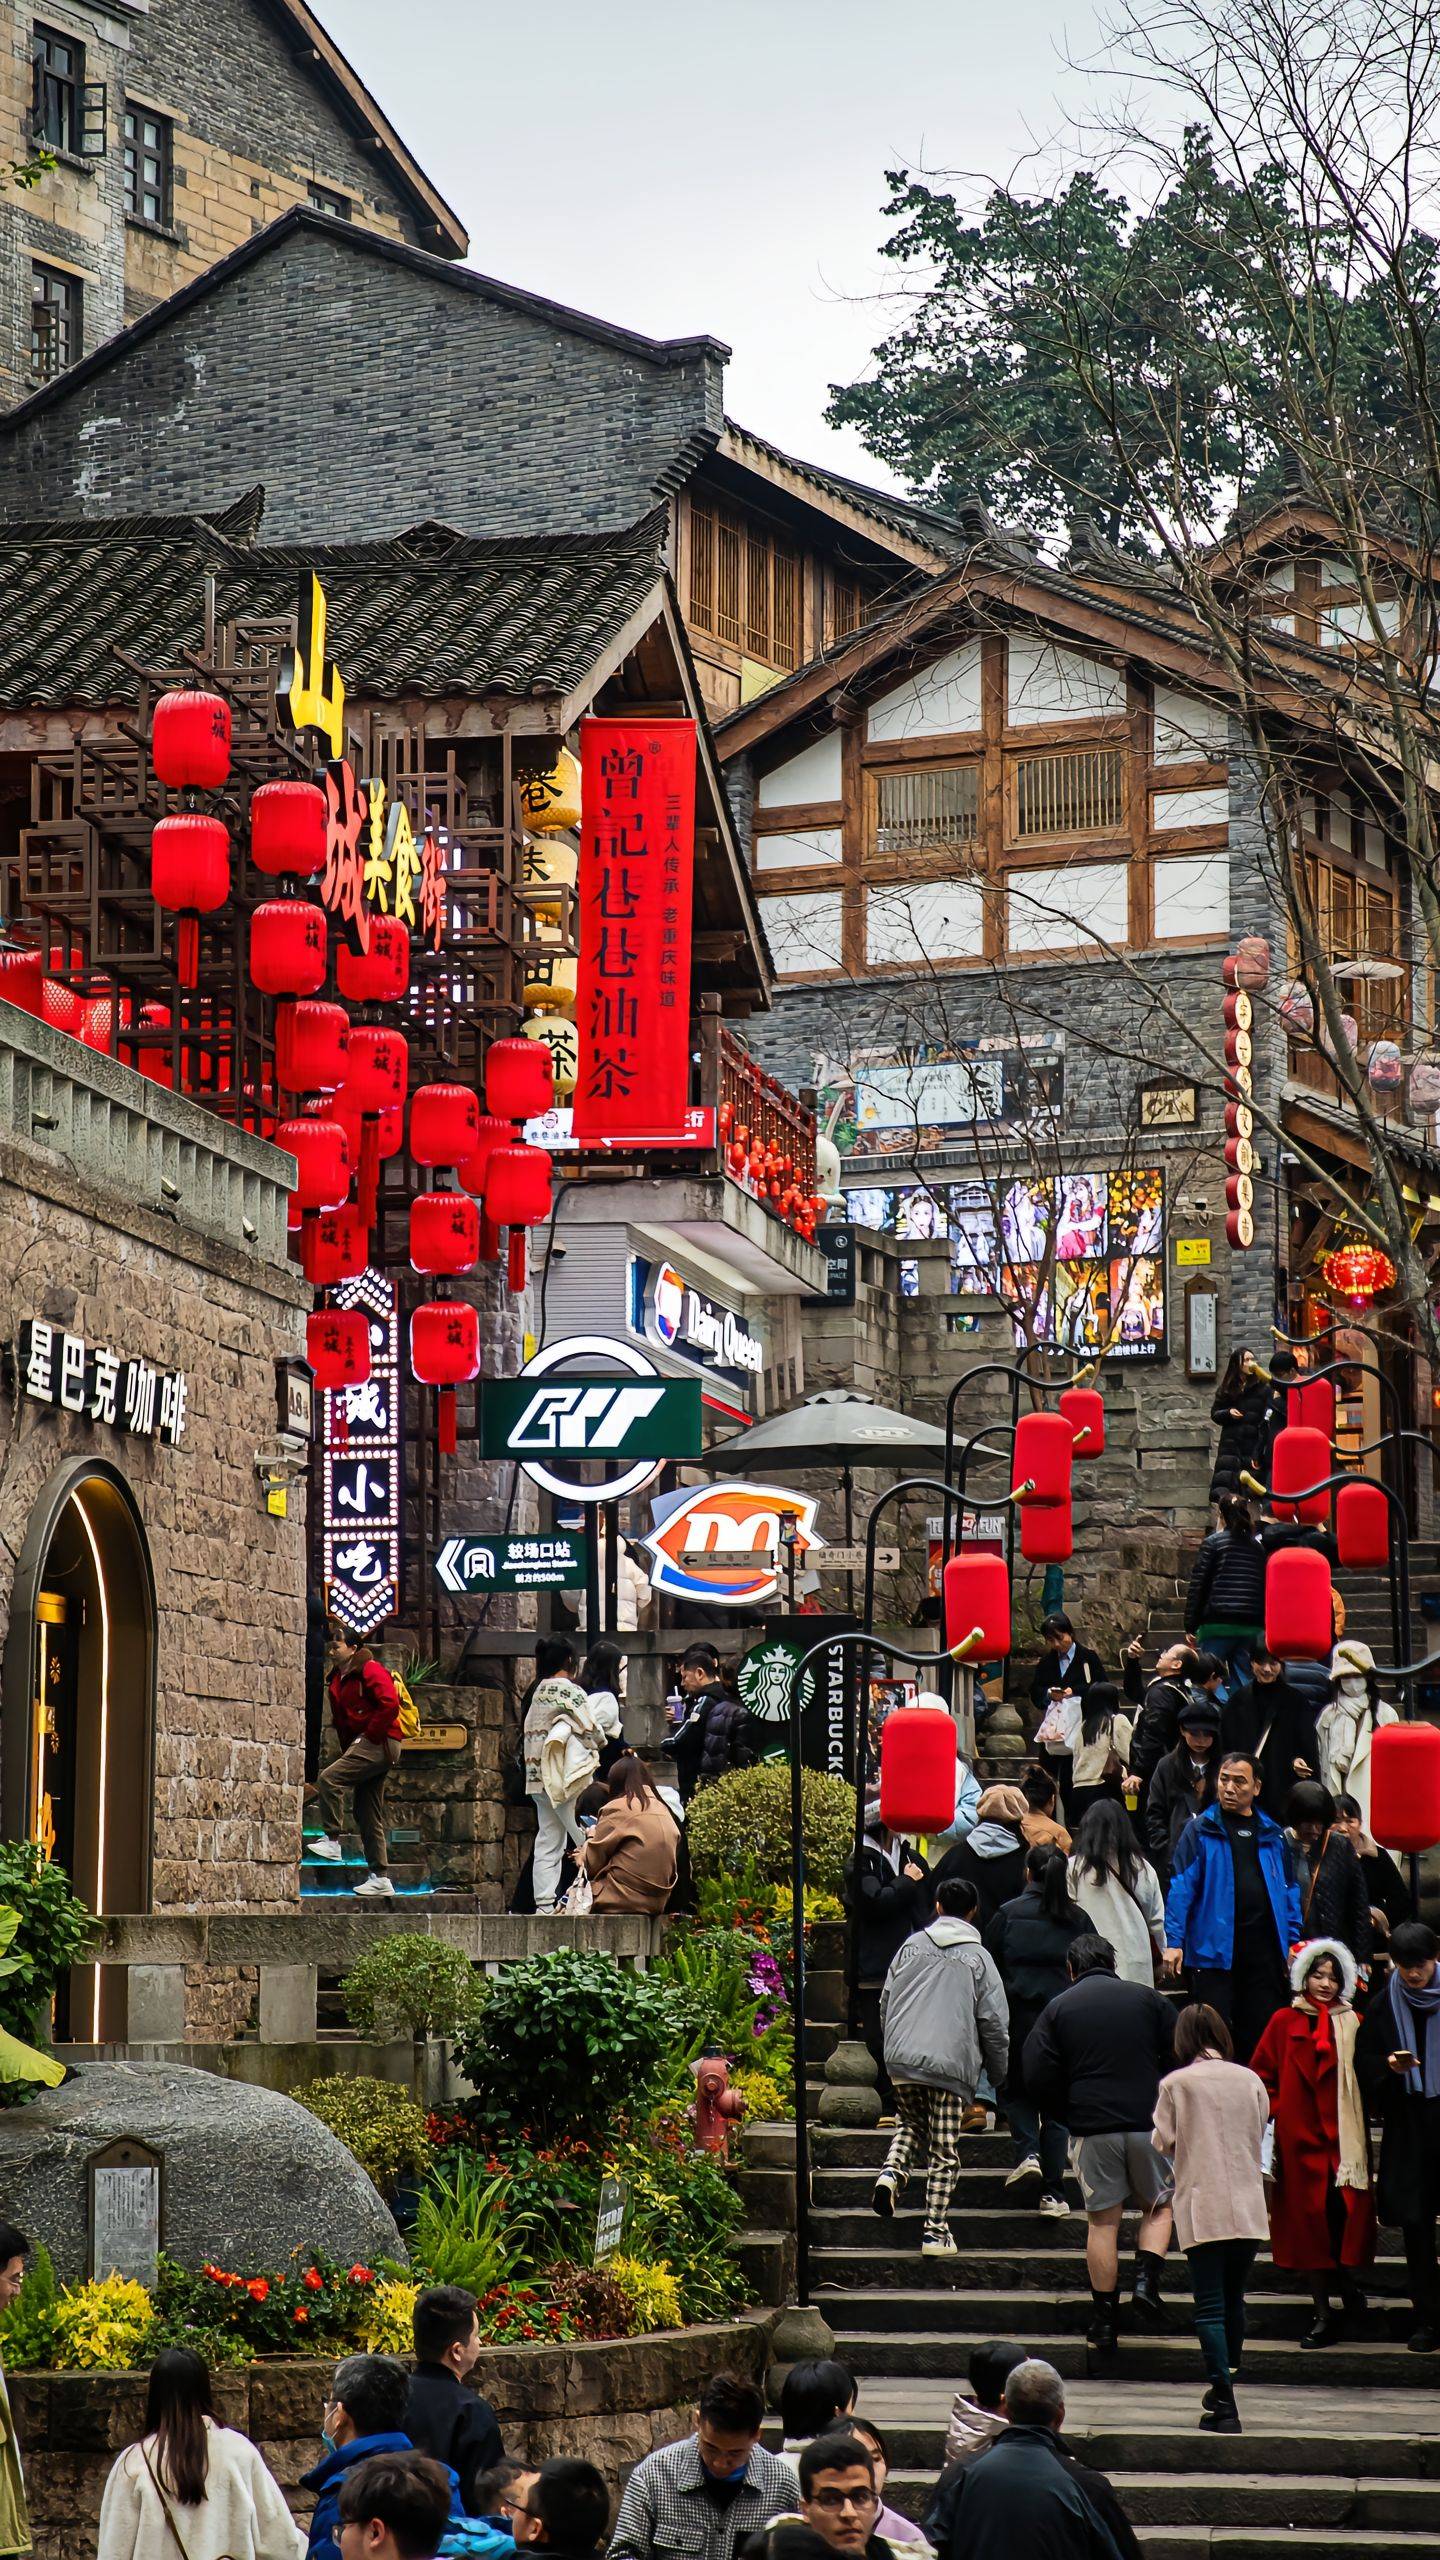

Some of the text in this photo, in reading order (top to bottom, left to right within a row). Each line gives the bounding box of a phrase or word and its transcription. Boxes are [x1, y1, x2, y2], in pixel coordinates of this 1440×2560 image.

[211, 710, 228, 744] 山城
[305, 918, 320, 949] 山城
[588, 747, 648, 1099] 曾記巷巷油茶
[375, 929, 393, 960] 山城
[660, 906, 679, 1008] 老重庆味道
[374, 1043, 391, 1075] 山城
[322, 1218, 339, 1247] 山城
[452, 1208, 467, 1237] 山城
[323, 1326, 341, 1355] 山城
[447, 1320, 464, 1348] 山城
[688, 1289, 764, 1374] Dairy Queen
[26, 1319, 188, 1446] 星巴克咖啡
[508, 1541, 571, 1559] 较场口站
[827, 1644, 844, 1783] STARBUCKS
